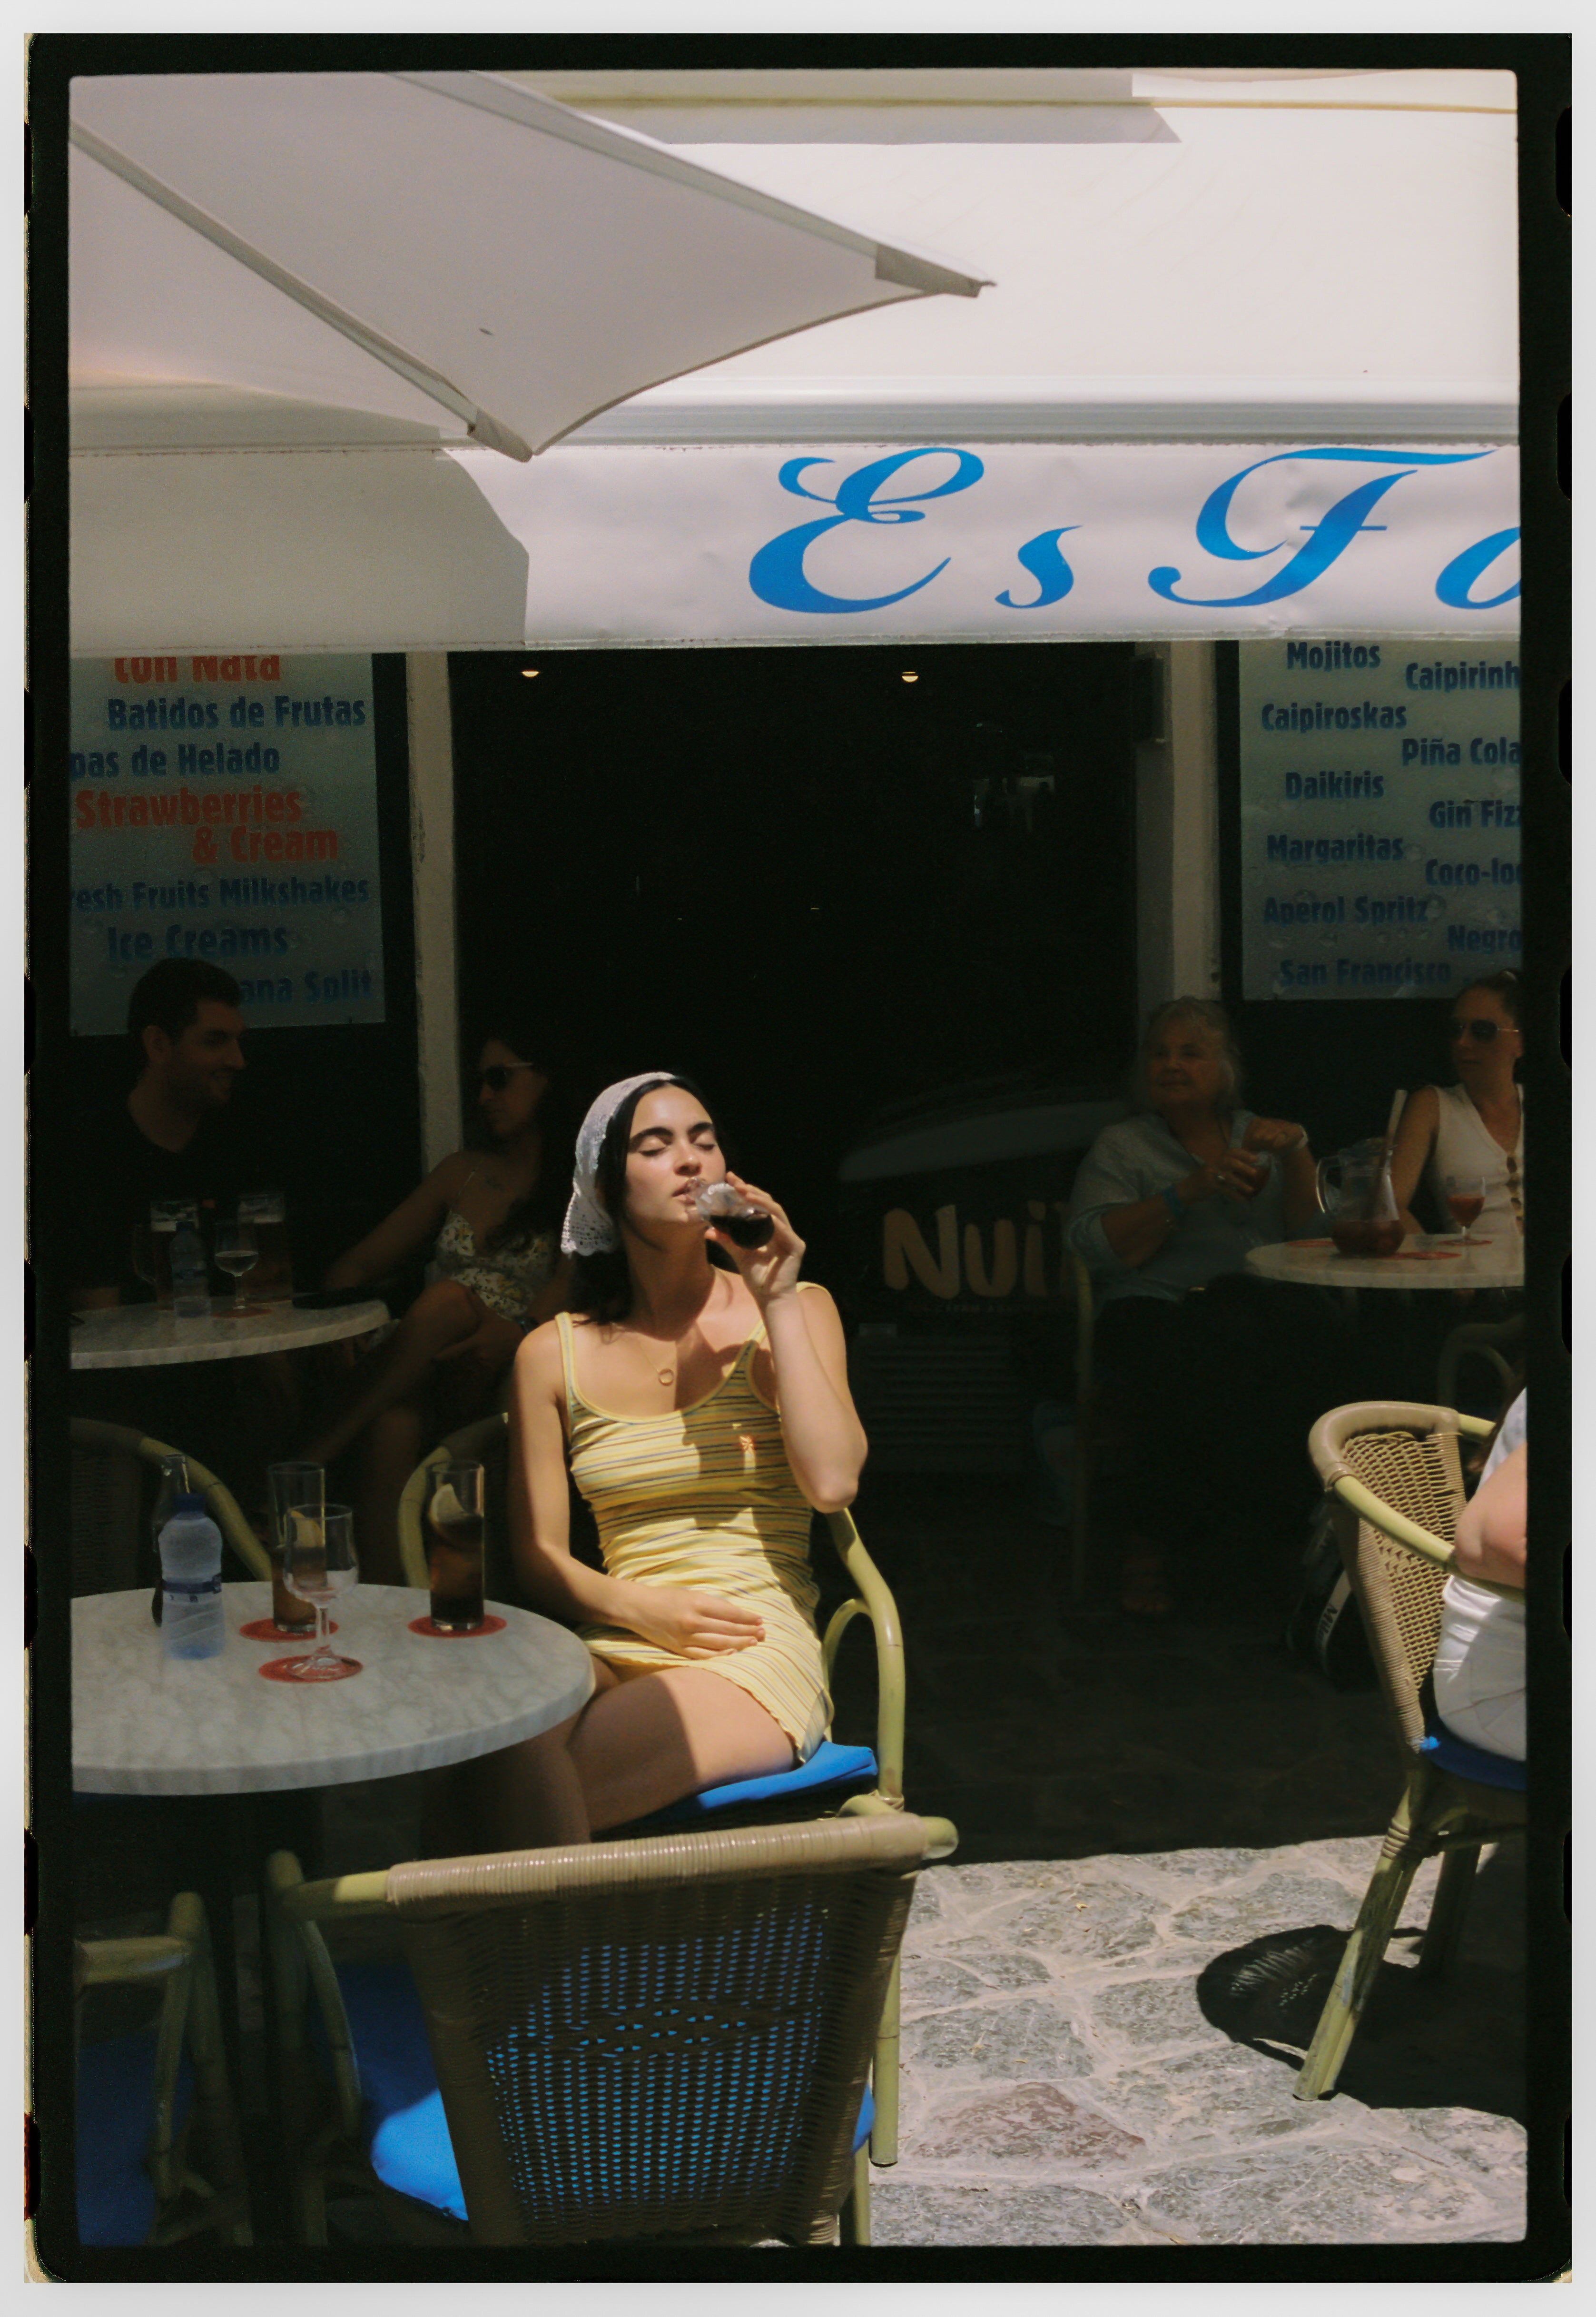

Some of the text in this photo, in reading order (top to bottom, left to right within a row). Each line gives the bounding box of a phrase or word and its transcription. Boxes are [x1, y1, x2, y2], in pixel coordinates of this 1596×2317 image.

[748, 446, 1084, 614] Es
[191, 655, 281, 683] Nata
[1287, 641, 1380, 672] Mojitos
[1406, 661, 1521, 692] Caipirinh
[108, 696, 366, 731] Batidos de Frutas
[1261, 701, 1407, 733] Caipiroskas
[131, 745, 167, 777] de
[178, 742, 280, 775] Helado
[1401, 737, 1521, 766] Piña Cola
[1285, 770, 1384, 800] Daikiris
[76, 785, 302, 829] Strawberries
[1429, 800, 1471, 829] Gin
[193, 825, 338, 865] & Cream
[1267, 832, 1404, 863] Margaritas
[133, 879, 211, 911] Fruits
[220, 875, 369, 906] Milkshakes
[1263, 895, 1429, 927] Aperol Spritz
[108, 924, 289, 962] Ice Creams
[305, 969, 372, 1004] Split
[1280, 957, 1452, 986] San Francisco
